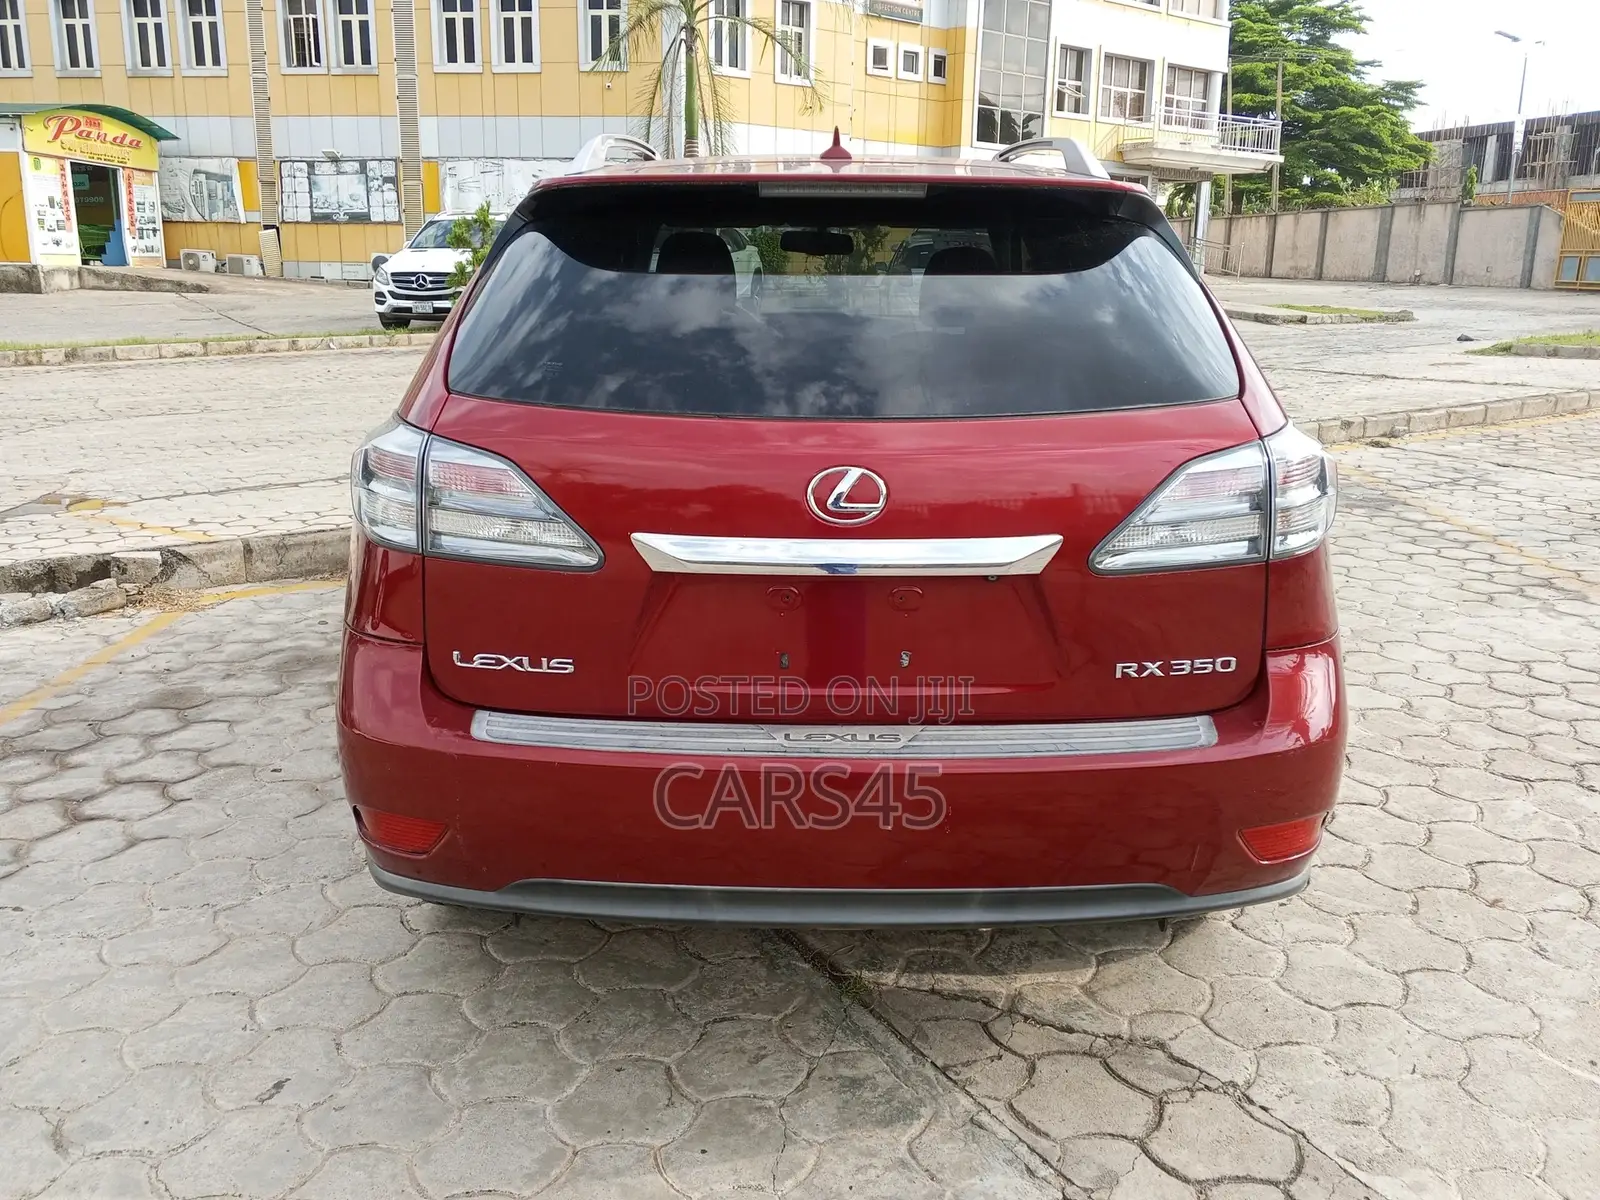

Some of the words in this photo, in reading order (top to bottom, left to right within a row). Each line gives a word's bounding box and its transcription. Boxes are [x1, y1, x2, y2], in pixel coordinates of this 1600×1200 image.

[44, 115, 143, 149] Panda
[453, 650, 575, 674] LEXUS
[1115, 661, 1165, 679] RX
[1169, 656, 1237, 675] 350
[783, 733, 901, 743] LEXUS
